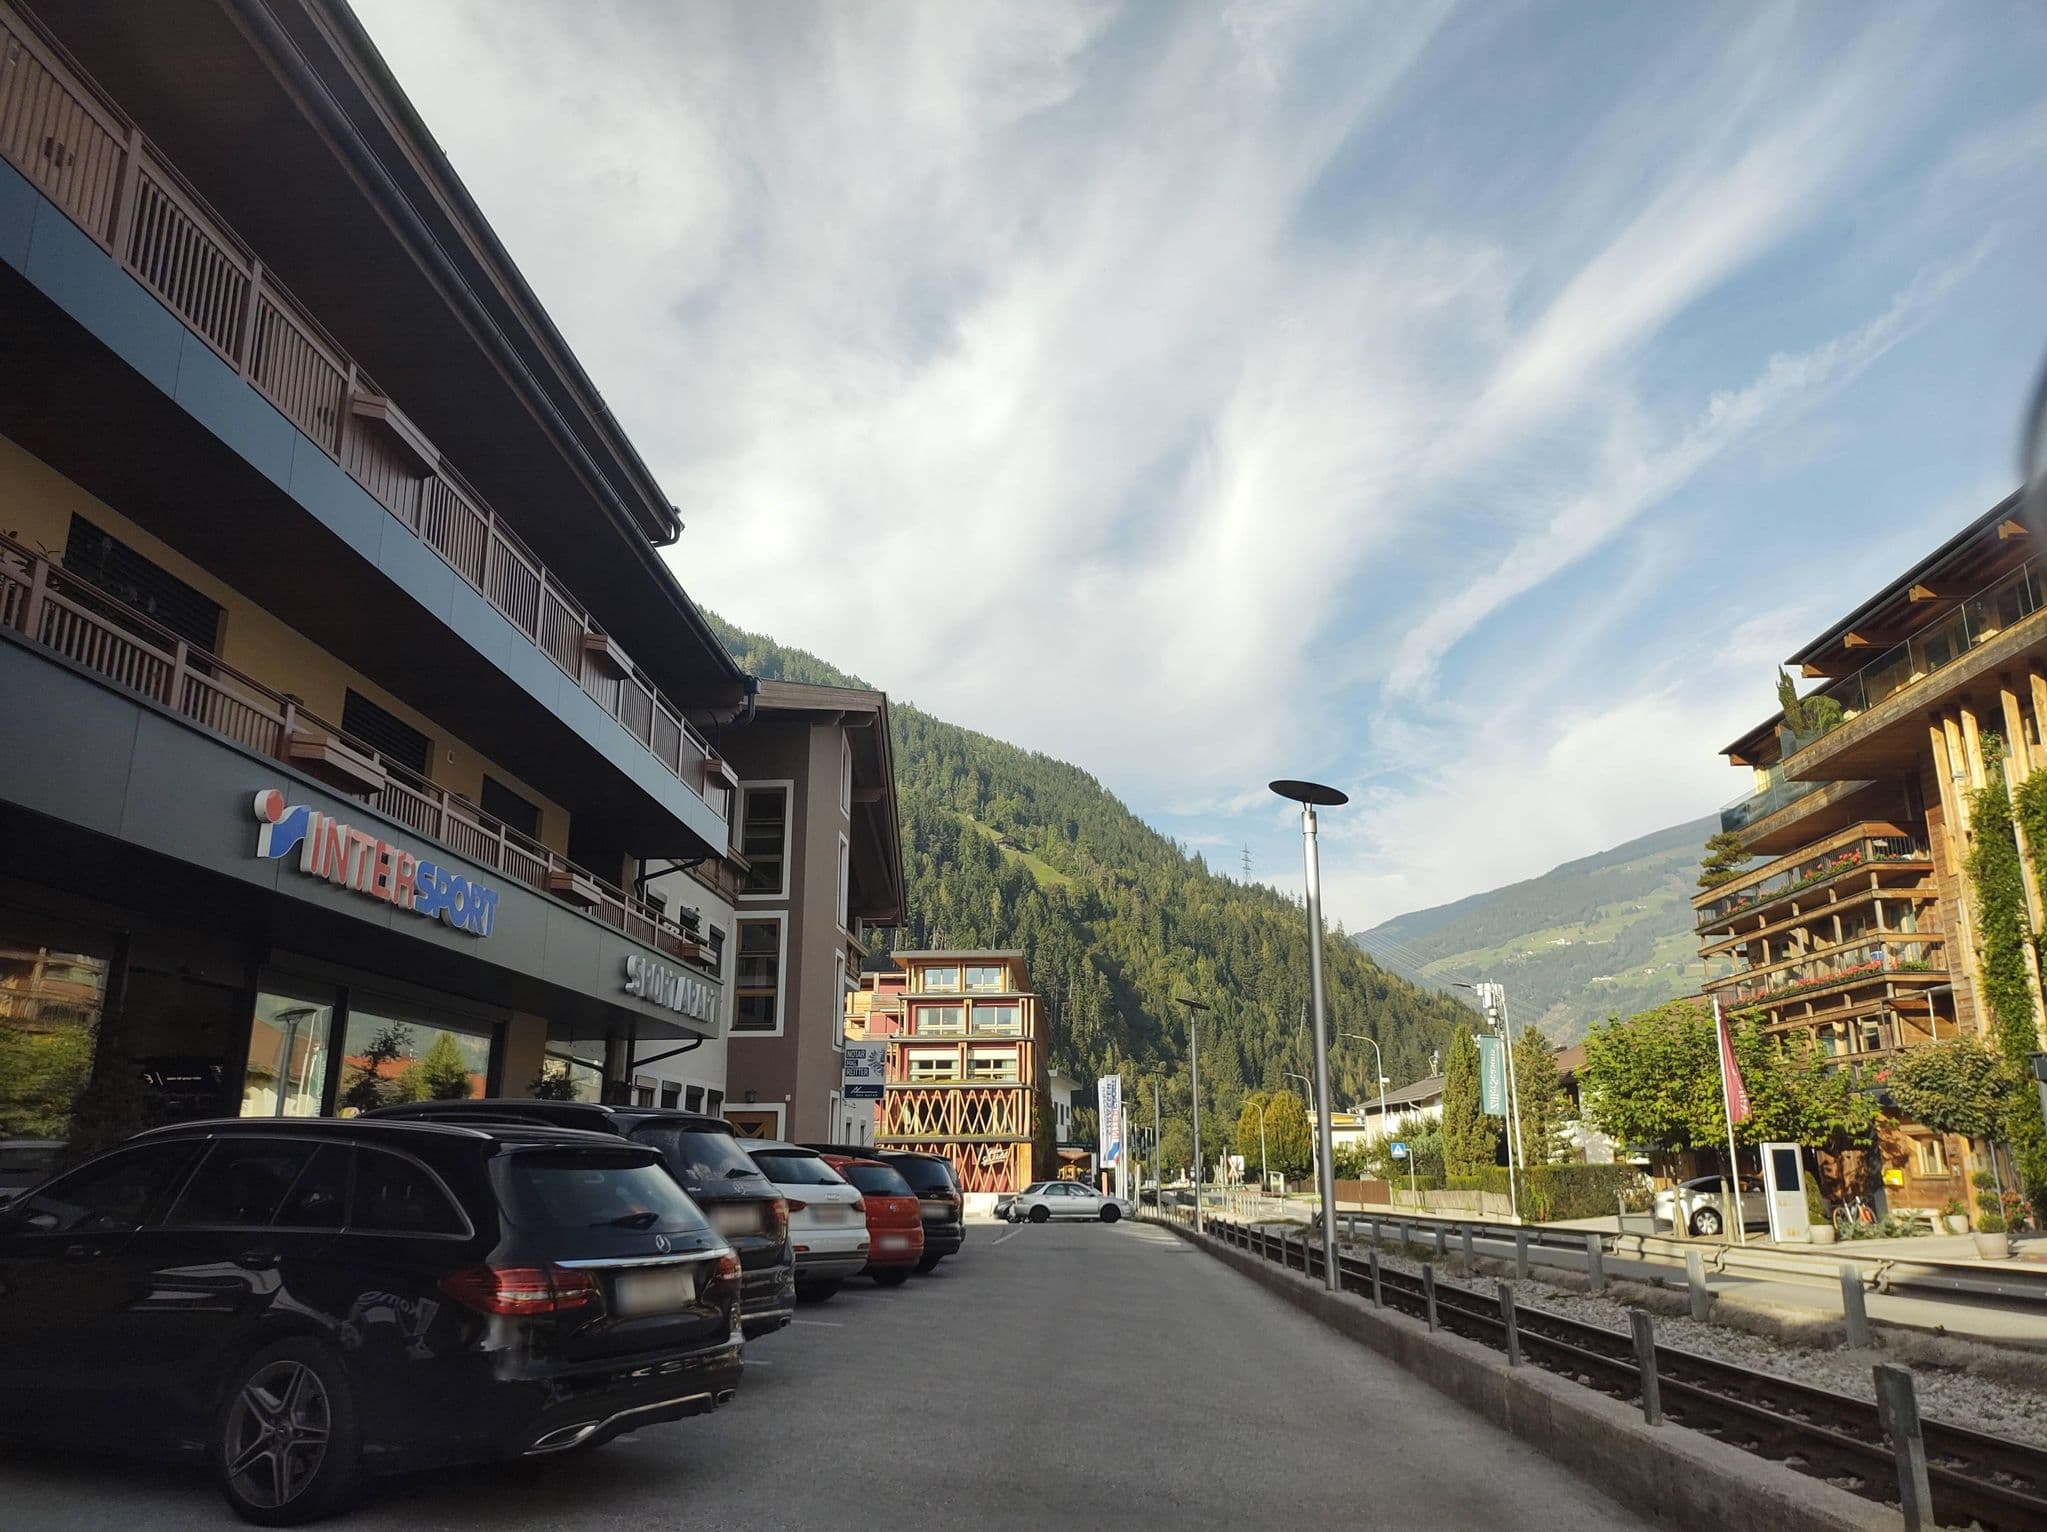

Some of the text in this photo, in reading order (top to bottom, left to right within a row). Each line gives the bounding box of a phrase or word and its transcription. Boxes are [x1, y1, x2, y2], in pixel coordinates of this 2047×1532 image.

[300, 811, 498, 938] INTERSPORT
[846, 1049, 866, 1058] NOTAR
[846, 1067, 869, 1076] REITTER
